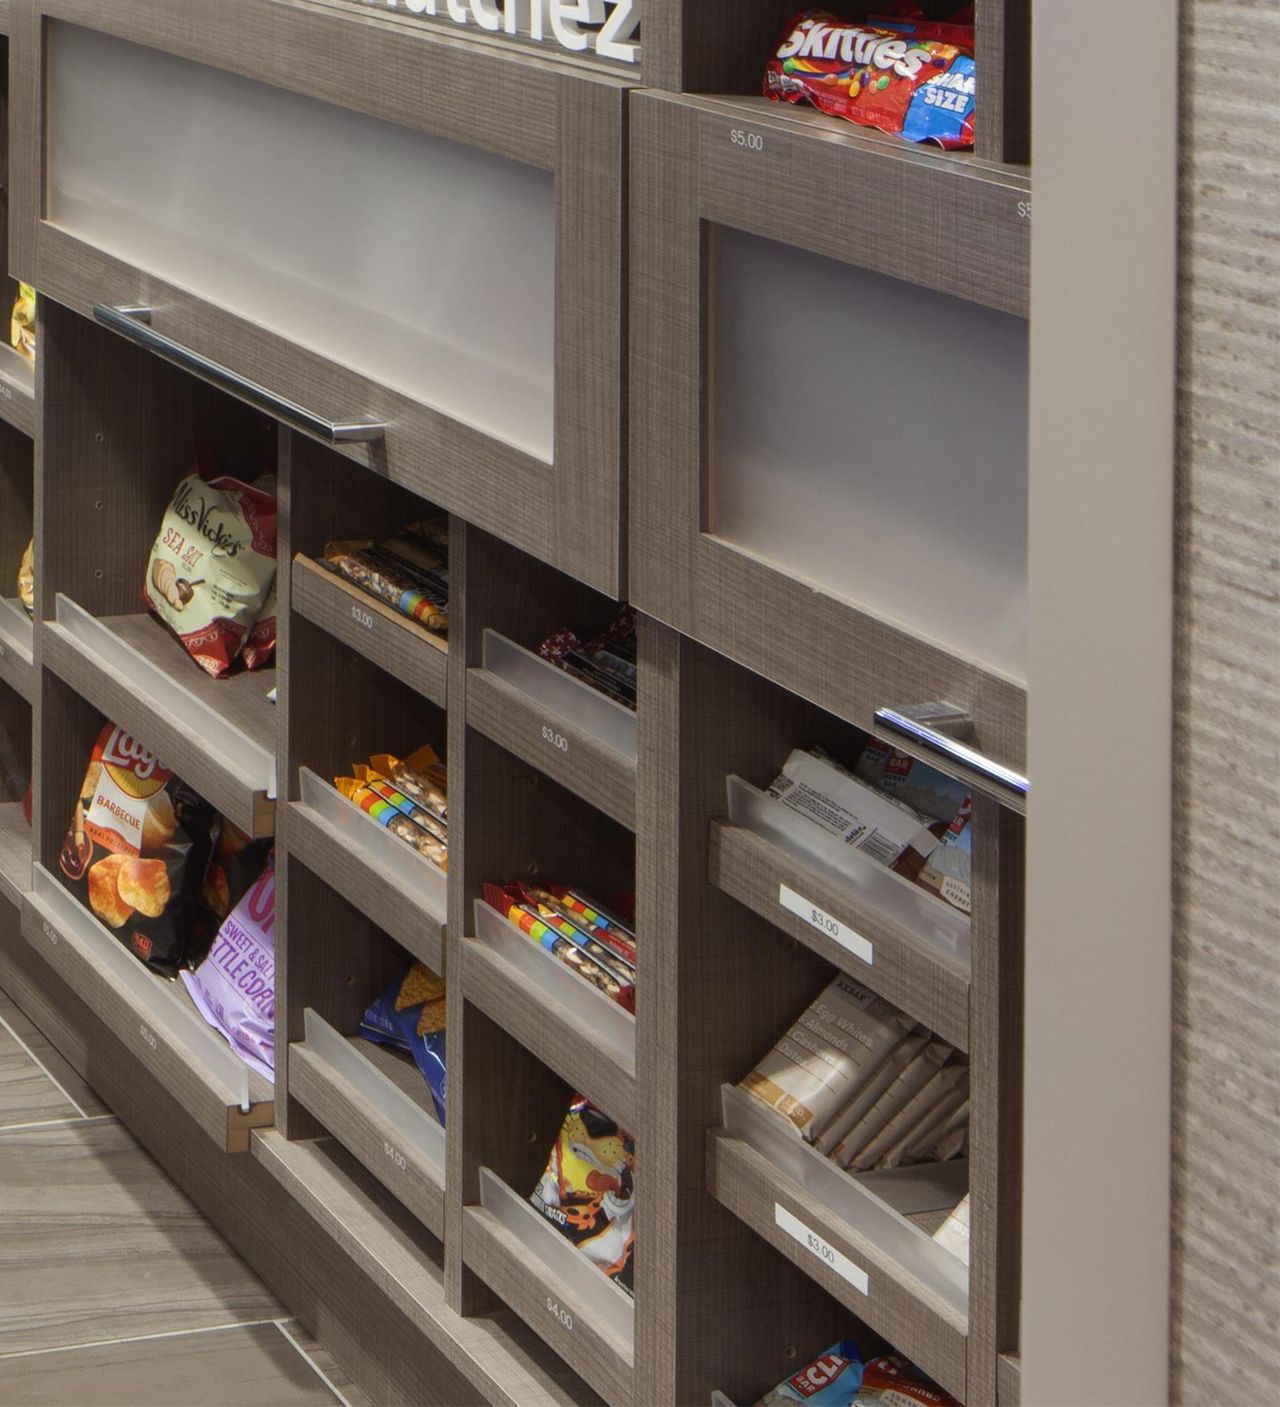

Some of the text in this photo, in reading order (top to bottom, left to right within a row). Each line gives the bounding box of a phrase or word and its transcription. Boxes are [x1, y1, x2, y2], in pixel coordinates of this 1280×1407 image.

[924, 88, 969, 113] SIZE
[730, 128, 763, 152] $5.00
[162, 527, 186, 557] SEA
[350, 605, 374, 630] $3.00
[541, 725, 568, 752] $3.00
[889, 756, 909, 769] BAR
[96, 794, 142, 831] BARBECUE
[811, 908, 839, 937] $3.00
[224, 919, 259, 963] SWEET &
[816, 1002, 837, 1025] Egg
[806, 1018, 850, 1053] Almonds
[778, 1041, 808, 1068] Dates
[383, 1142, 408, 1170] $4.00
[545, 1205, 568, 1226] SNACKS
[806, 1232, 835, 1264] $3.00
[545, 1295, 573, 1330] $4.00
[796, 1374, 816, 1393] BAR
